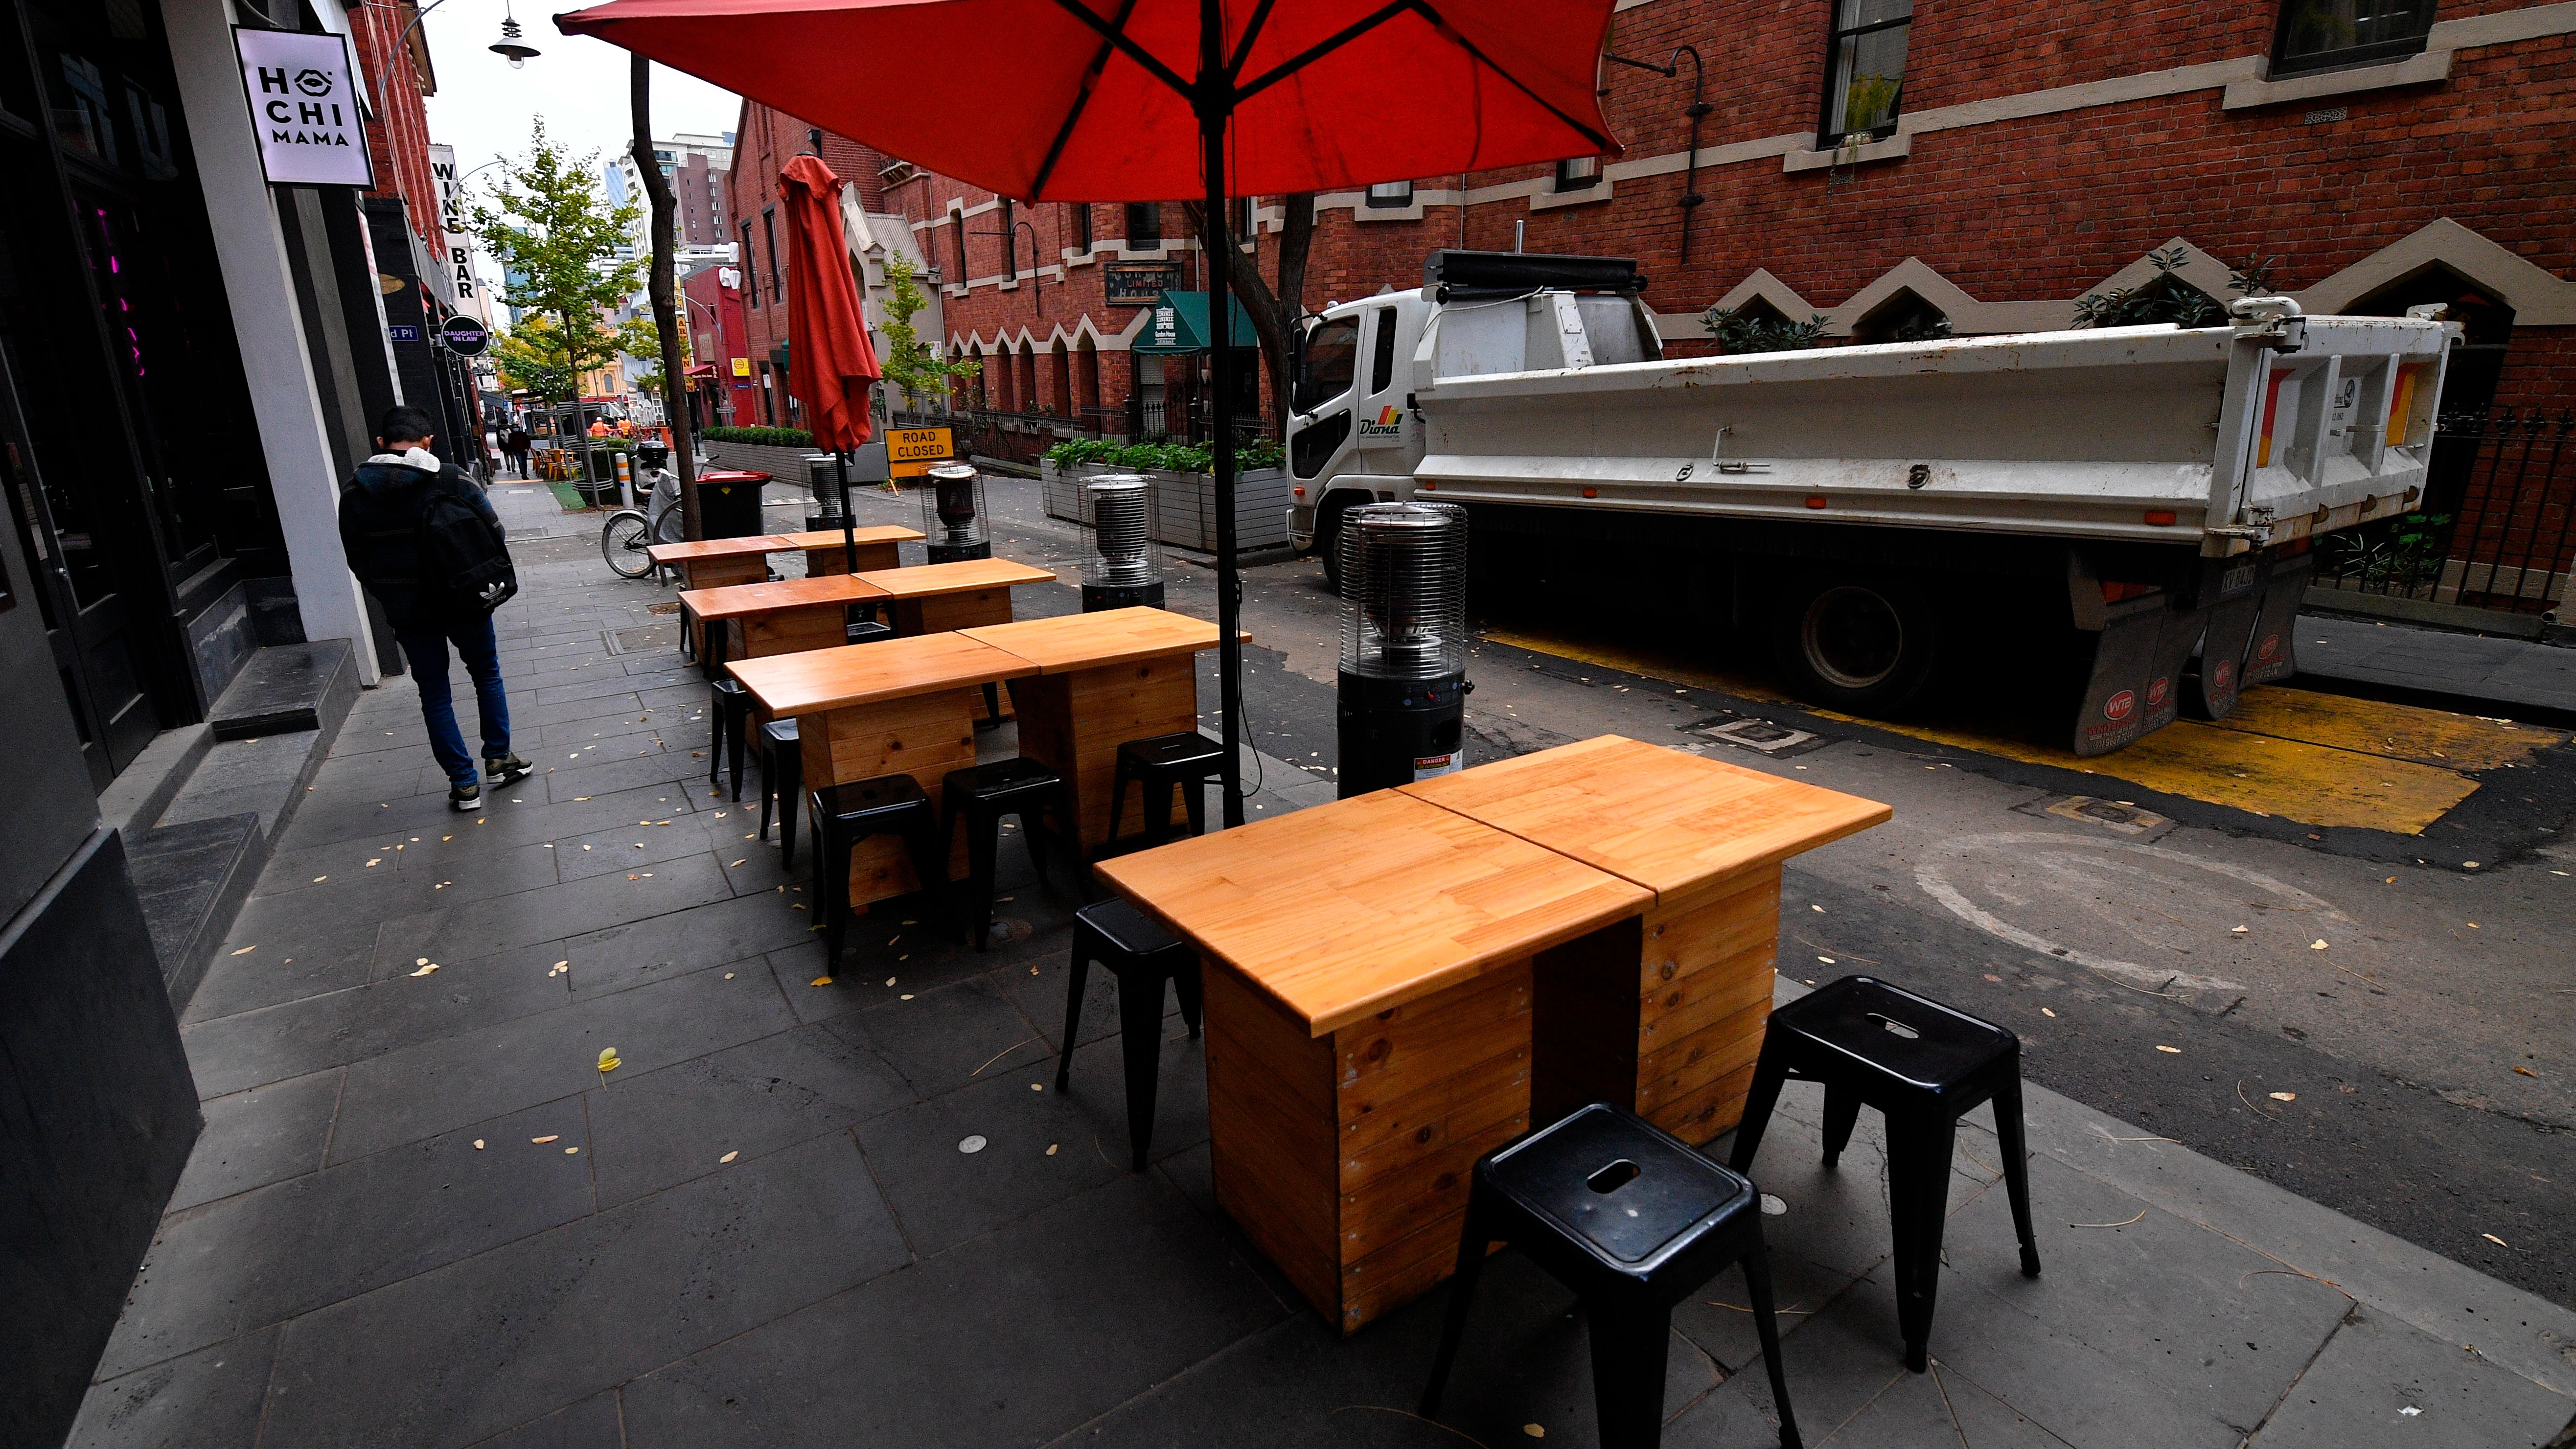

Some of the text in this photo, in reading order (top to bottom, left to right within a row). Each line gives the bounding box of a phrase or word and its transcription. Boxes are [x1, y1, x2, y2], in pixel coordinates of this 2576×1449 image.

[266, 100, 343, 126] CHI
[272, 129, 349, 146] MAMA
[432, 162, 474, 298] WINE BAR
[1119, 287, 1169, 298] HOUS
[401, 329, 414, 338] Pt
[1359, 419, 1400, 435] Diona
[902, 431, 936, 443] ROAD
[898, 444, 944, 457] CLOSED
[483, 595, 507, 608] adidas
[2149, 683, 2166, 700] WTB
[2109, 696, 2132, 713] WTB
